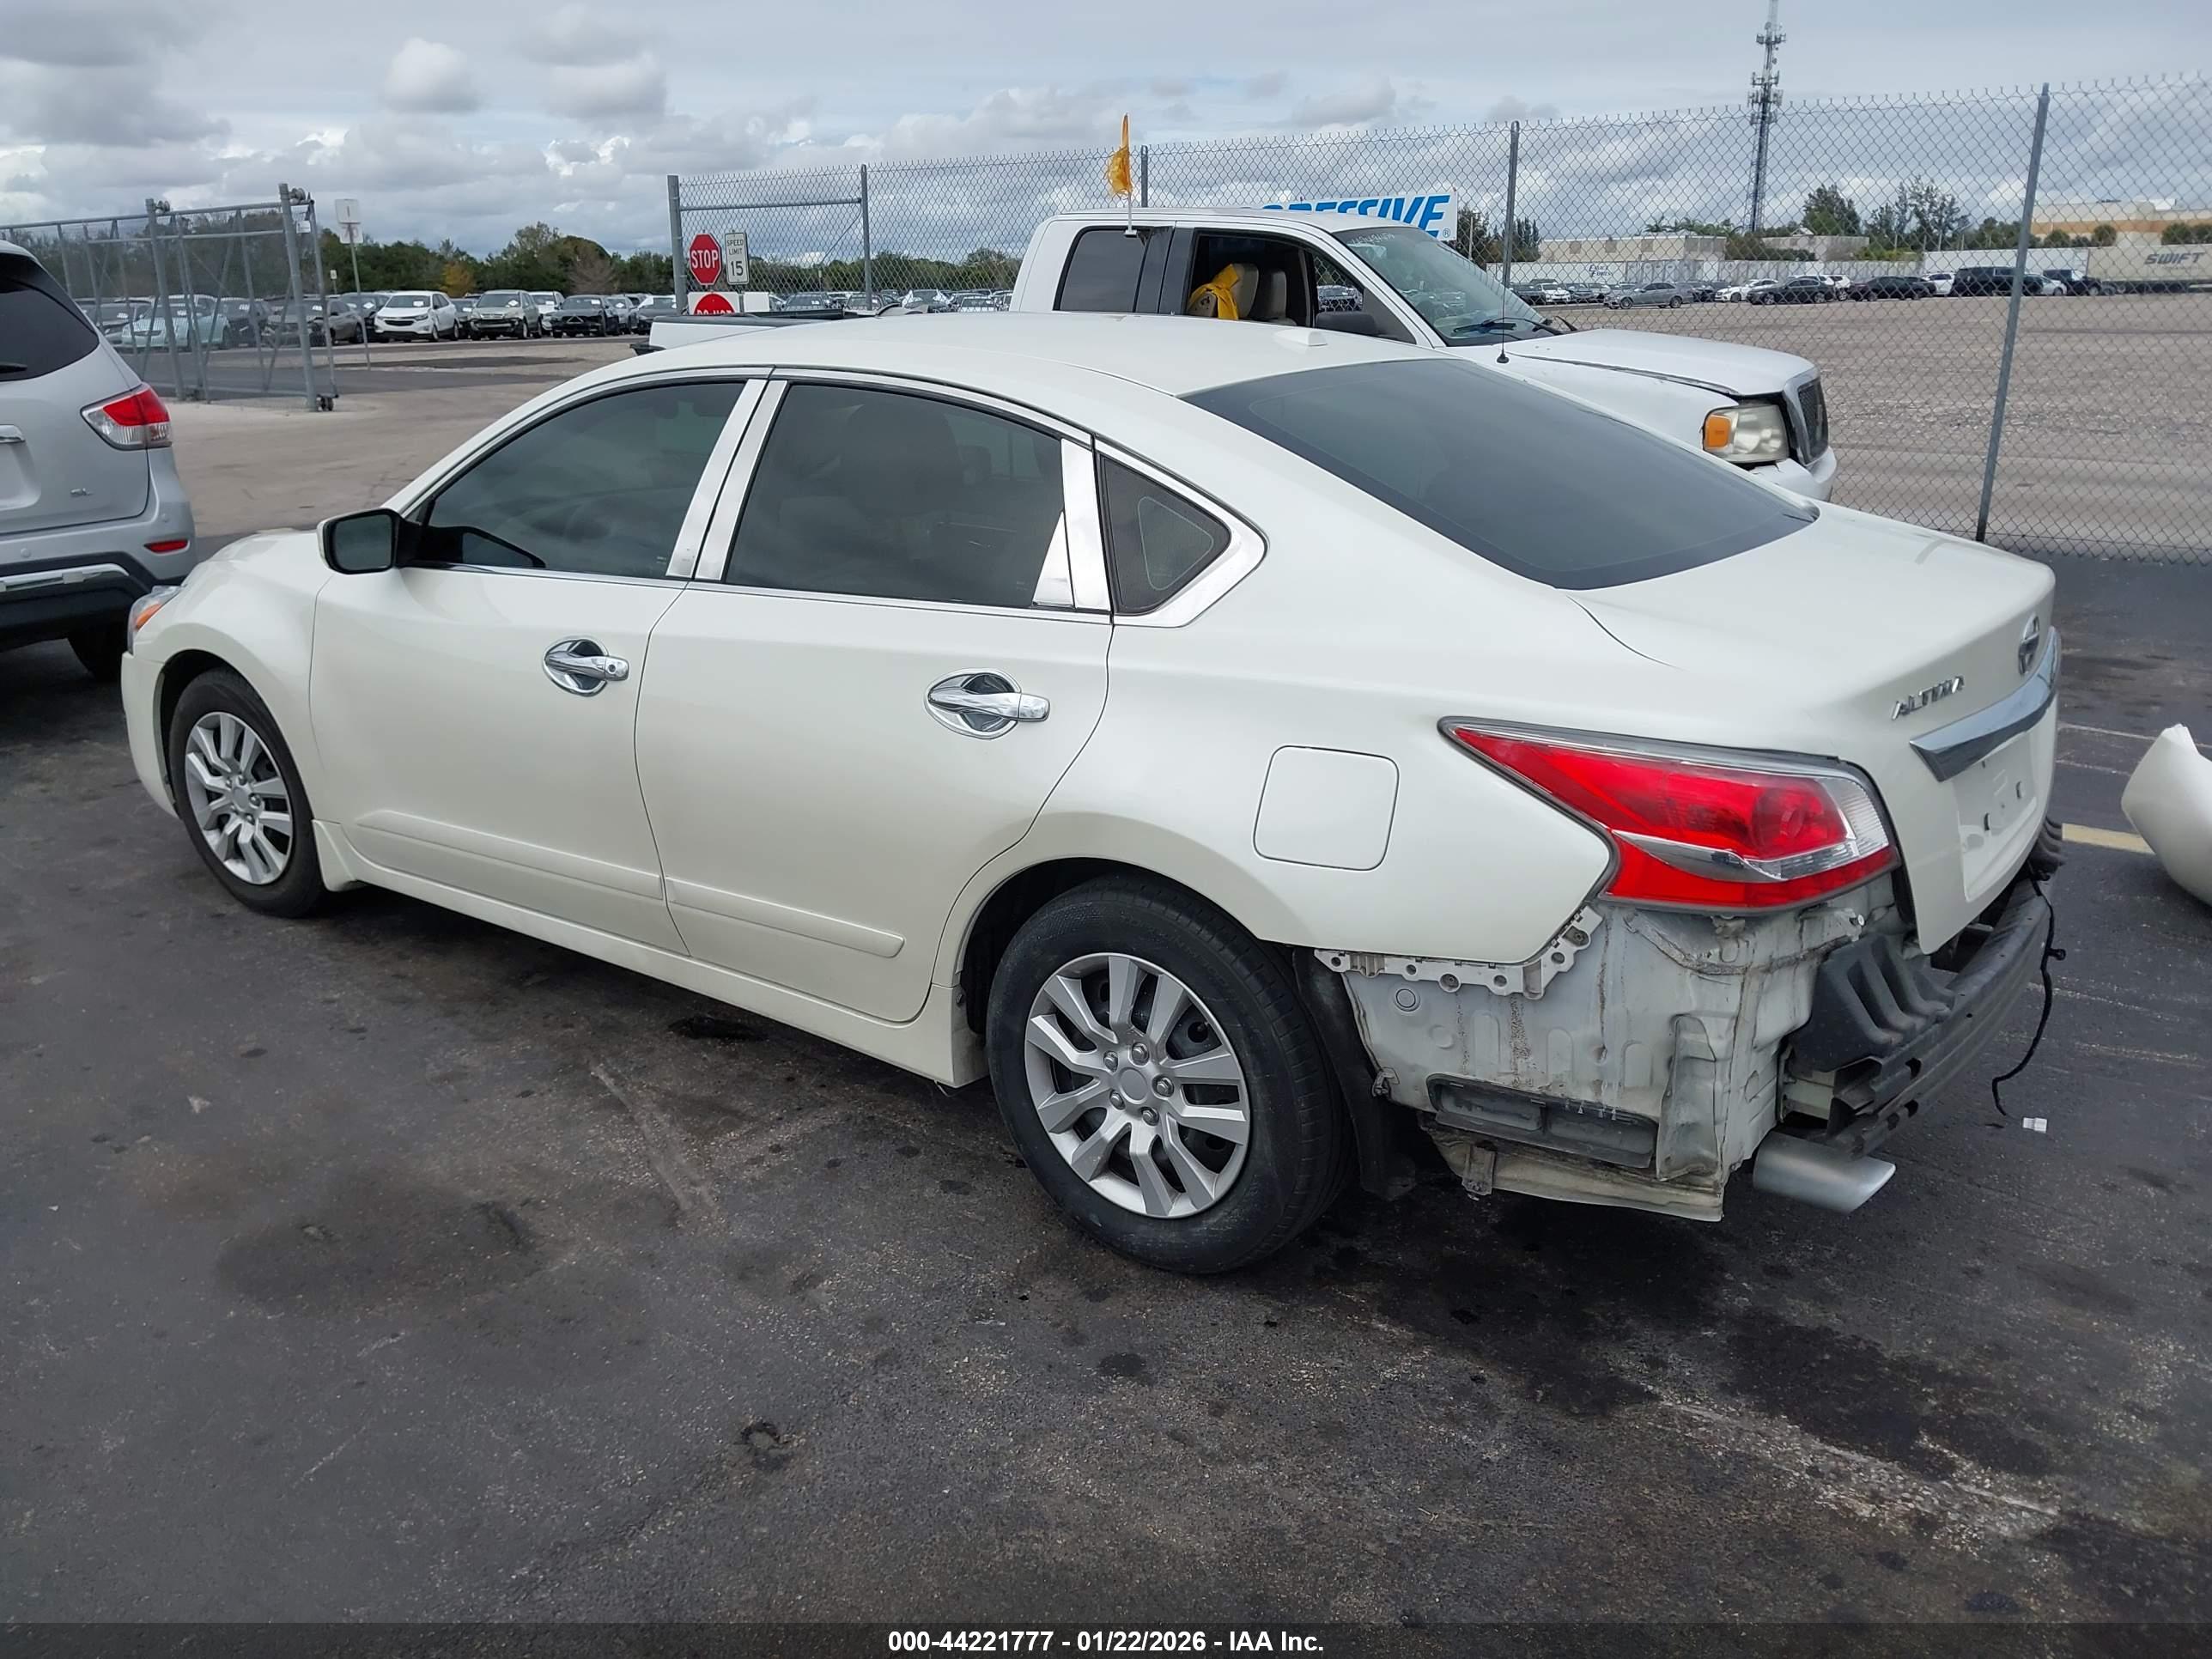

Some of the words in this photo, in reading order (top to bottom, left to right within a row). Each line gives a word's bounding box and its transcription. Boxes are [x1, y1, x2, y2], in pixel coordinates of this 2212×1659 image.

[691, 250, 719, 269] STOP
[2144, 252, 2206, 264] SWIFT
[731, 260, 744, 276] 15
[1892, 675, 1965, 720] ALTIMA
